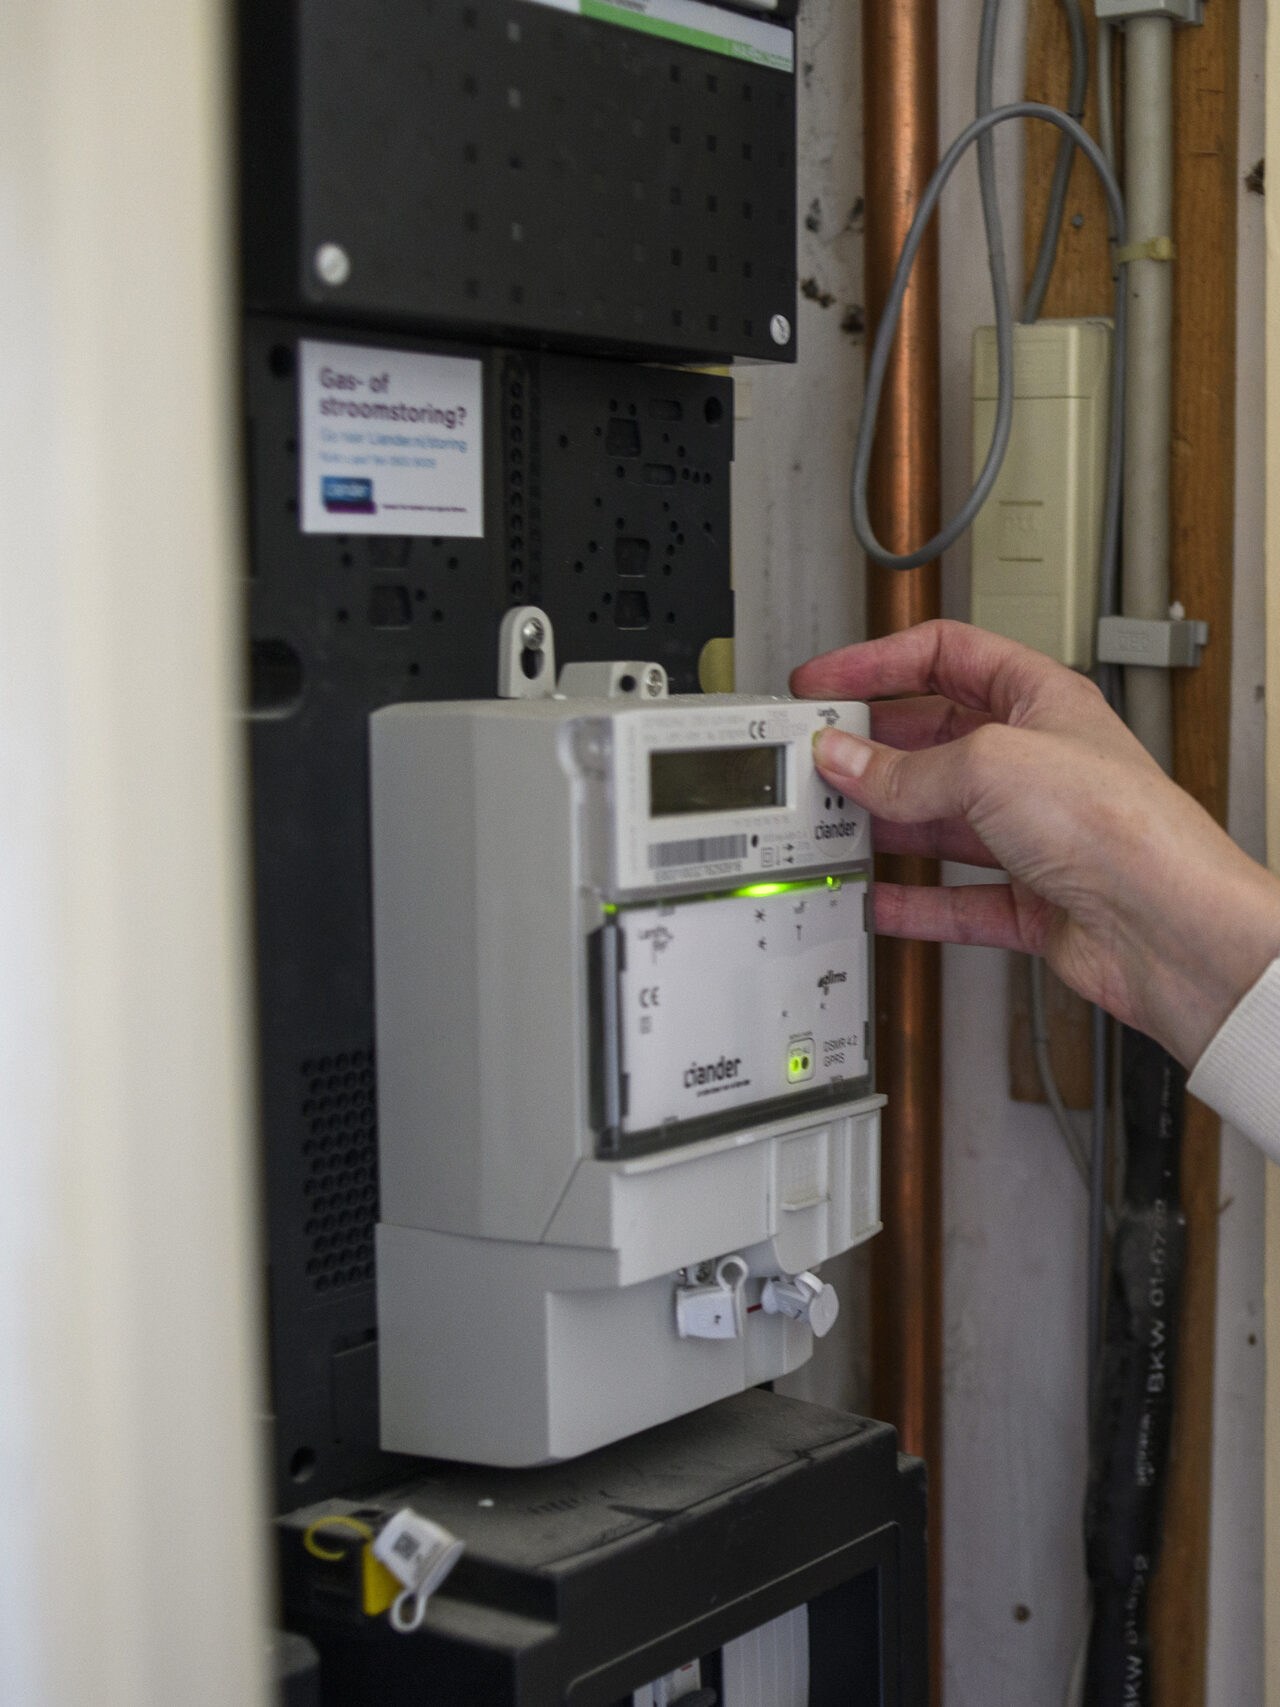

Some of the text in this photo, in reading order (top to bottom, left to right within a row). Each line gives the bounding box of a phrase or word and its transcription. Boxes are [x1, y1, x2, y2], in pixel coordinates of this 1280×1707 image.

[320, 367, 389, 393] Gas- of
[319, 397, 467, 429] stroomstoring?
[1147, 1318, 1166, 1392] BKW
